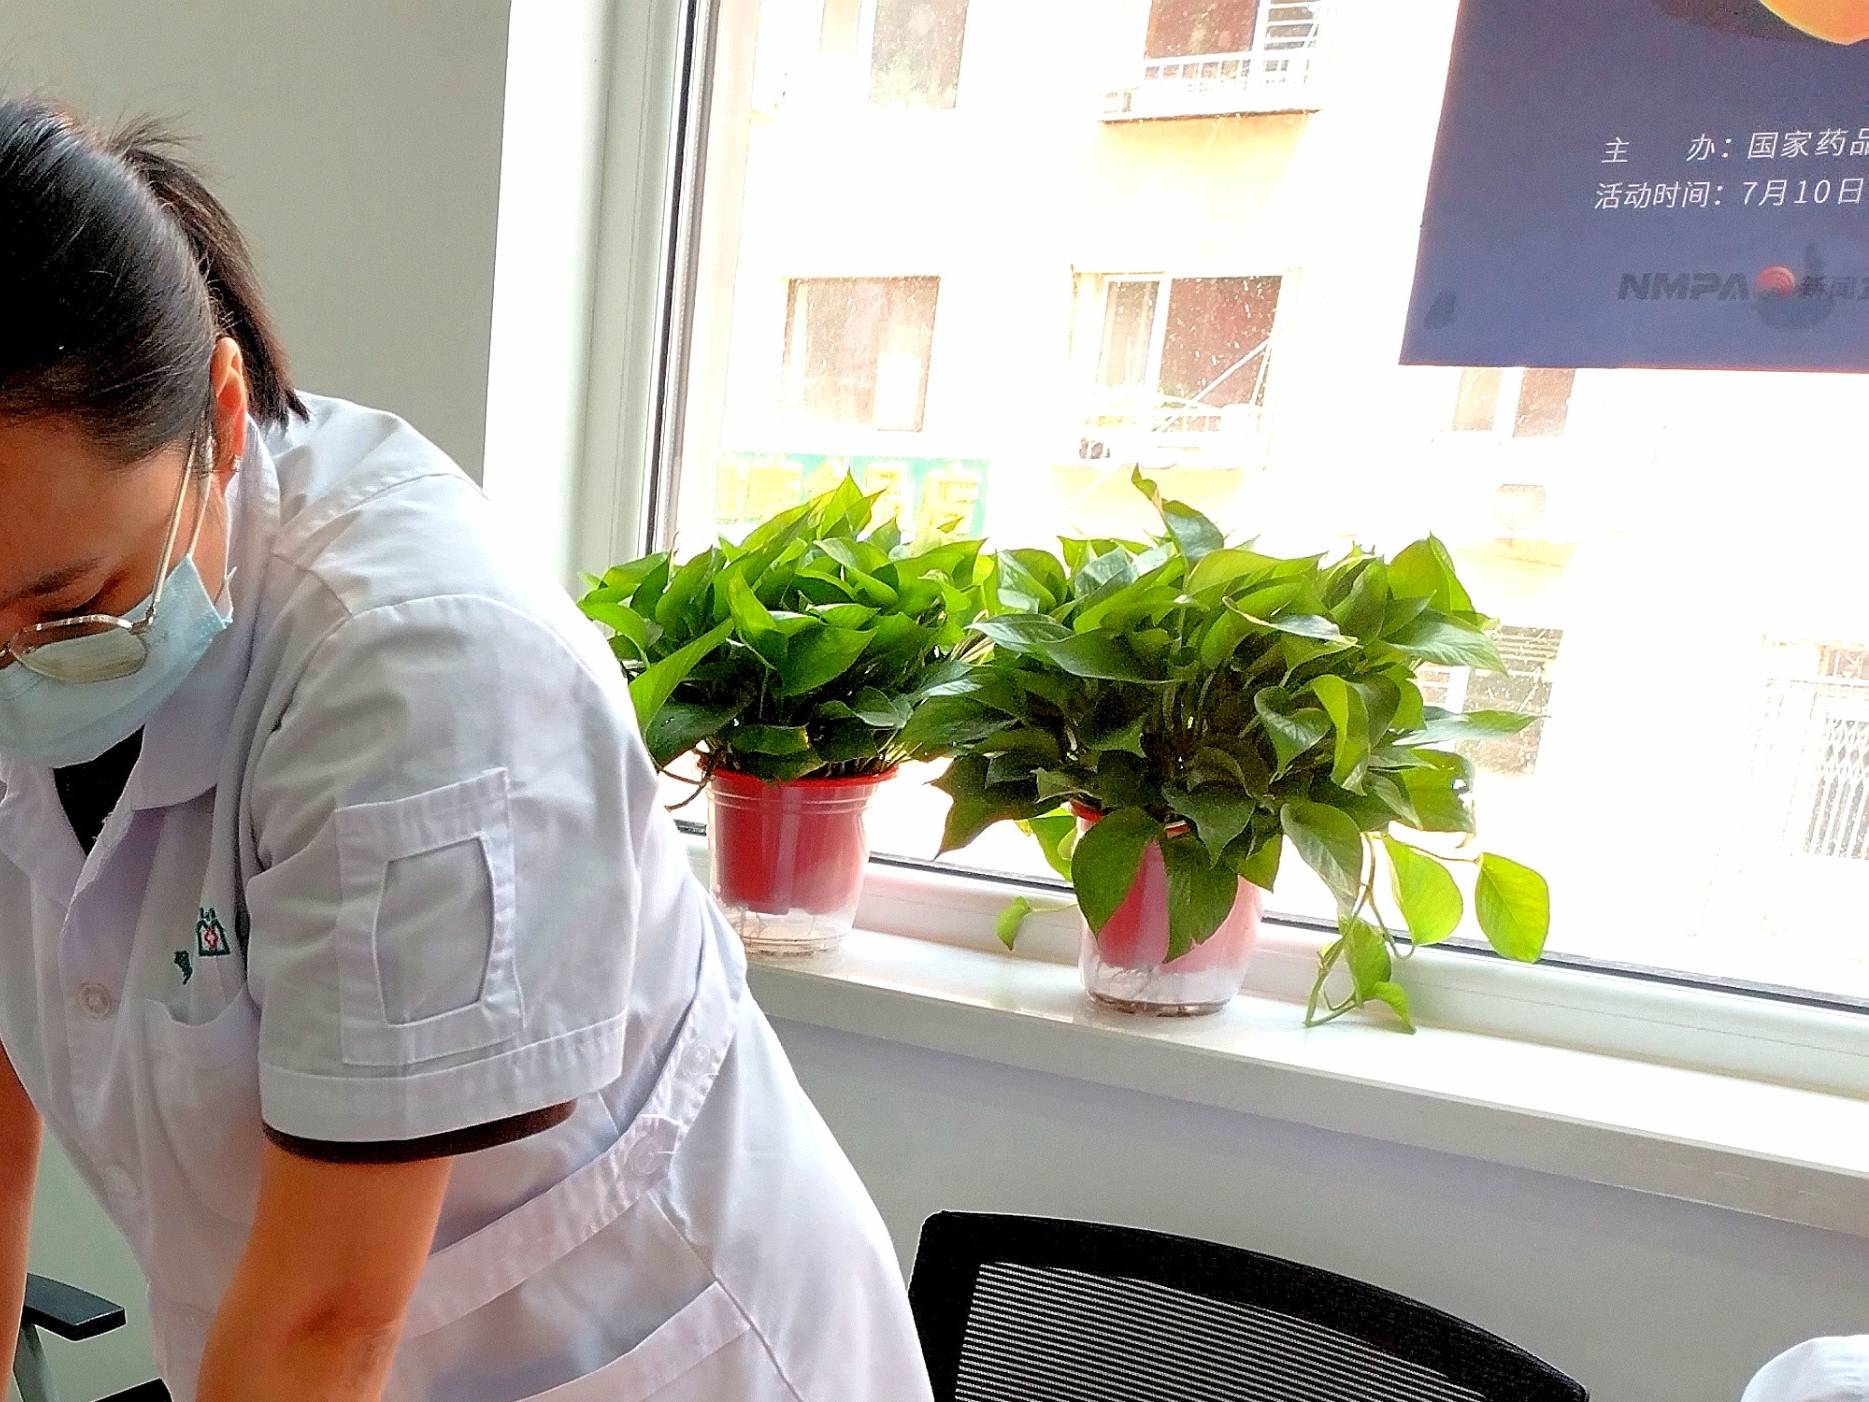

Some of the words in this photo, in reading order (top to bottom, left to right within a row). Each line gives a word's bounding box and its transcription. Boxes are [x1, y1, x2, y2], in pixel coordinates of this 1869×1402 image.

[1601, 136, 1630, 164] 主
[1594, 177, 1865, 211] 活动时间：7月10日
[1617, 272, 1750, 301] NMPA
